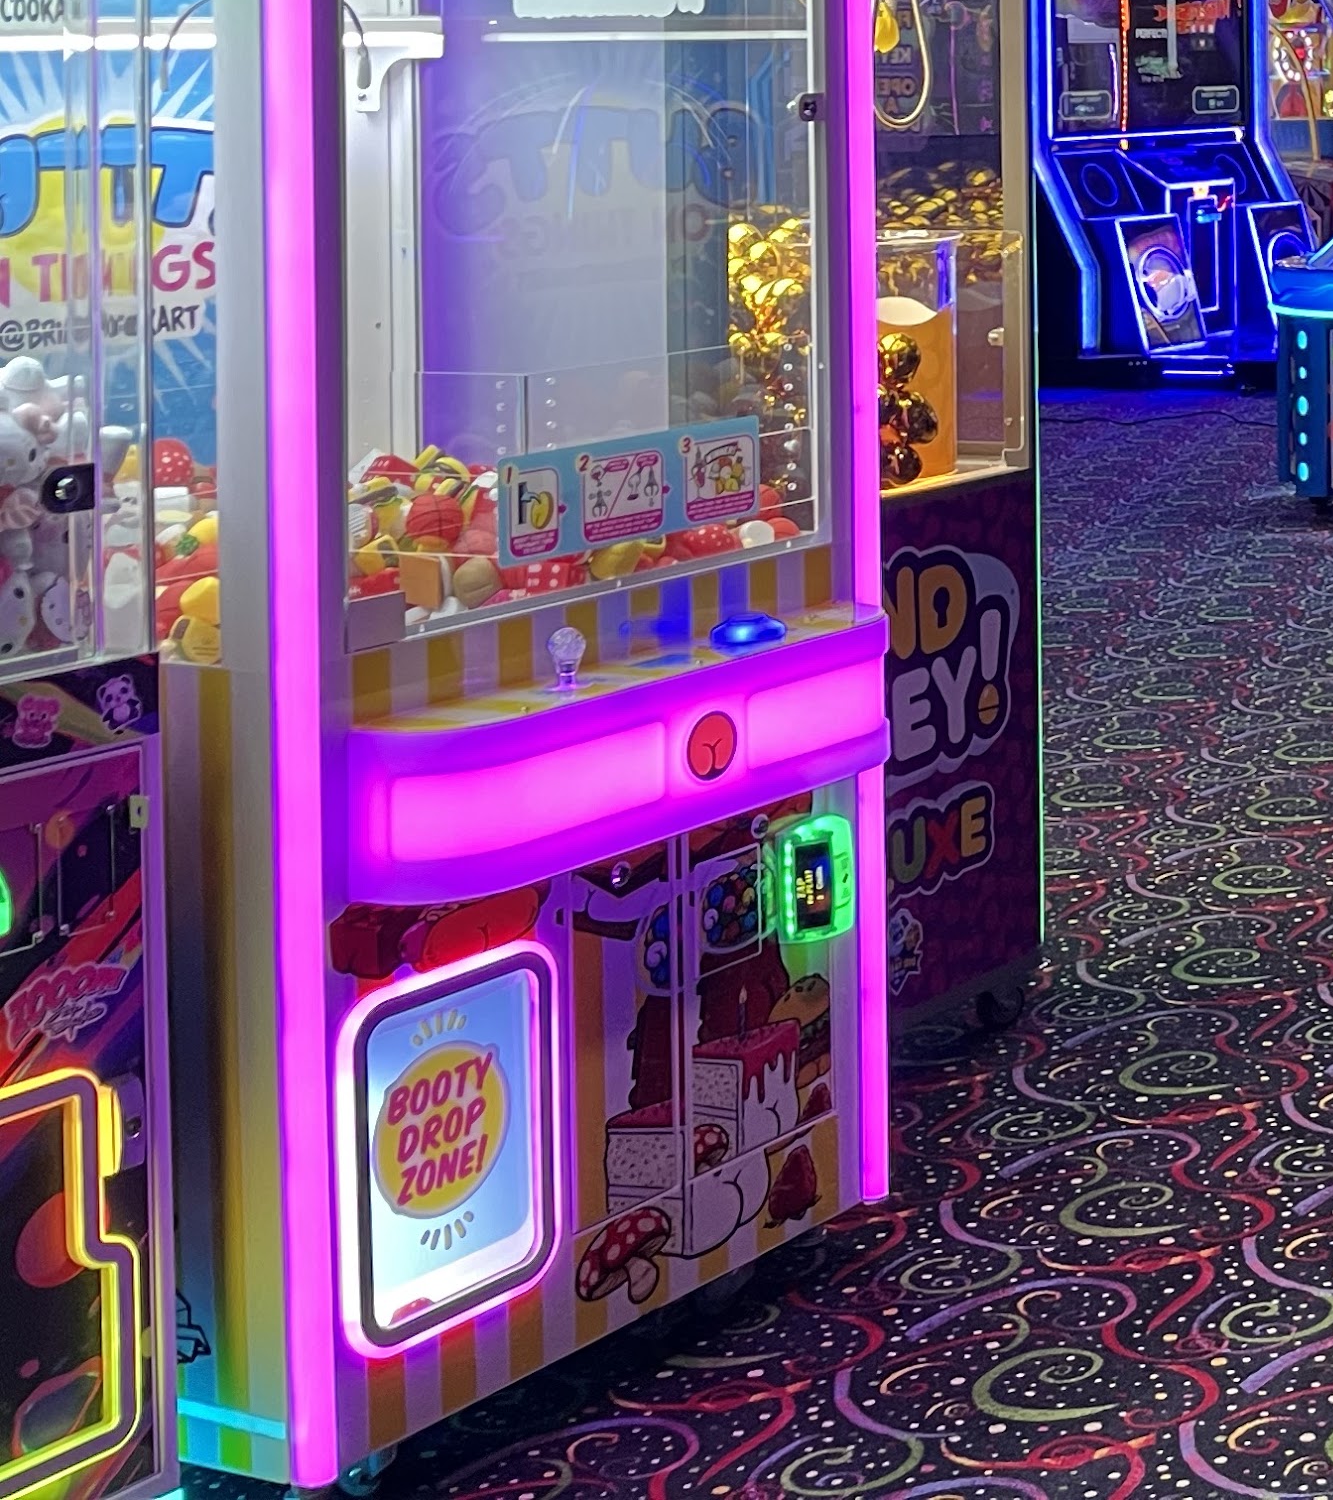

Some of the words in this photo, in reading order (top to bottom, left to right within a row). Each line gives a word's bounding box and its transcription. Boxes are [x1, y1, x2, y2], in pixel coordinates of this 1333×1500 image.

[506, 465, 513, 484] 1
[578, 454, 591, 472] 2
[681, 436, 692, 454] 3
[890, 795, 987, 886] UXE
[387, 1051, 493, 1126] BOOTY
[397, 1096, 487, 1164] DROP
[397, 1133, 489, 1207] ZONE!
